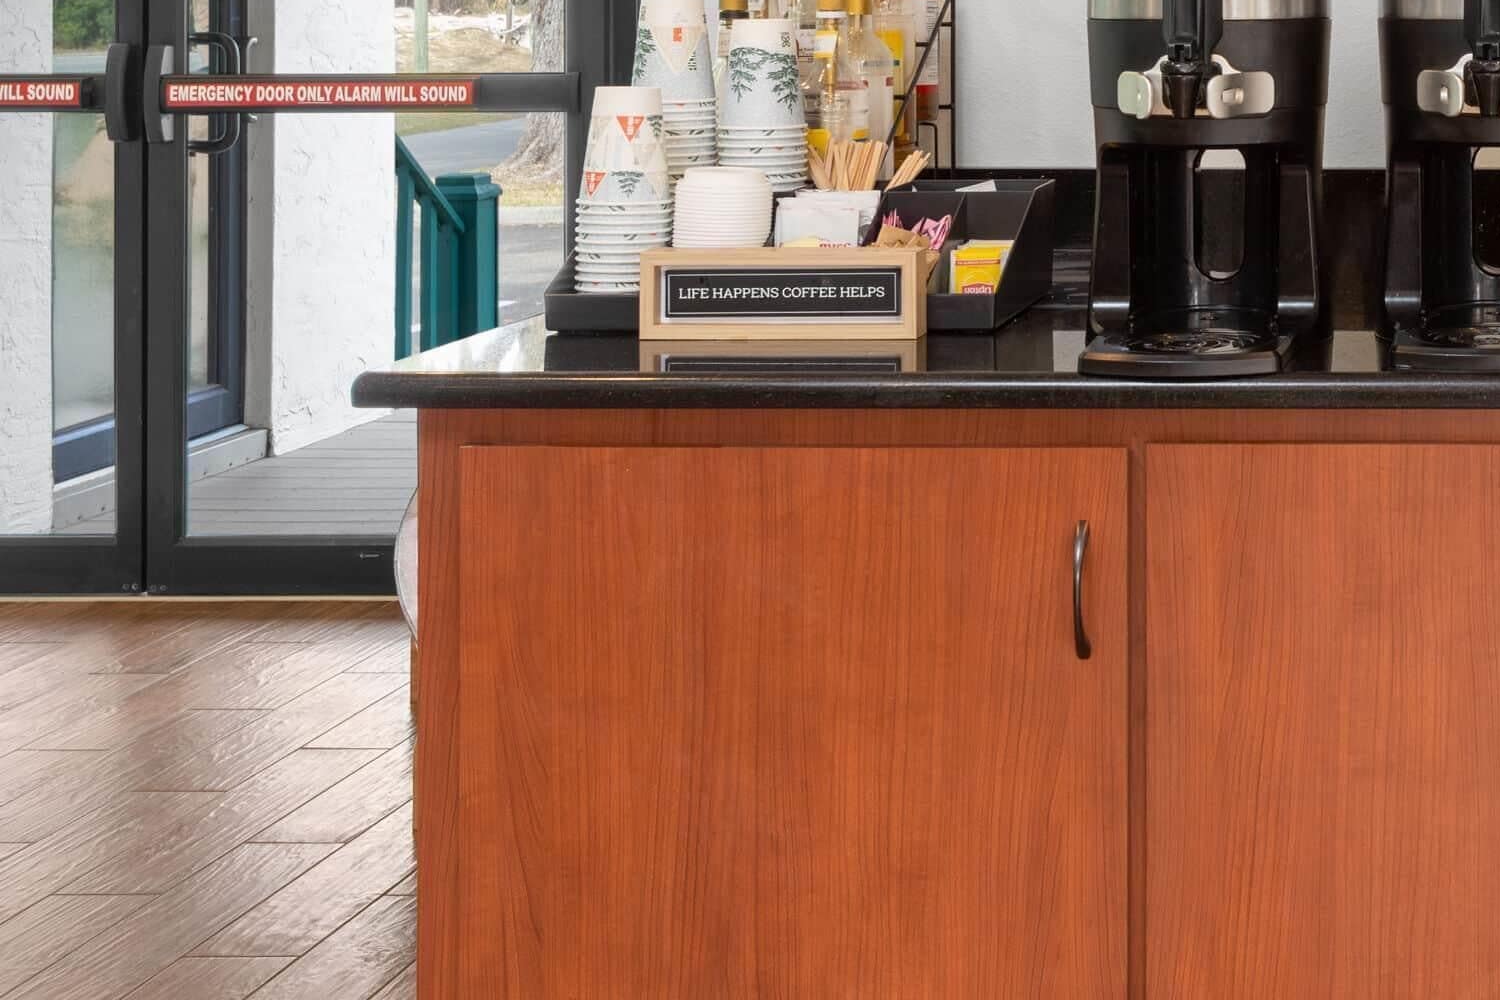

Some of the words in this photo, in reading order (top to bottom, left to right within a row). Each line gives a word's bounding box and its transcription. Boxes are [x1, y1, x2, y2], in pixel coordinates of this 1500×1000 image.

[27, 83, 74, 101] SOUND
[169, 84, 254, 102] EMERGENCY
[255, 85, 294, 102] DOOR
[297, 85, 333, 102] ONLY
[335, 85, 381, 102] ALARM
[384, 85, 417, 103] WILL
[420, 86, 467, 103] SOUND
[679, 287, 709, 299] LIFE
[712, 287, 779, 299] HAPPENS
[782, 286, 837, 298] COFFEE
[840, 286, 885, 298] HELPS
